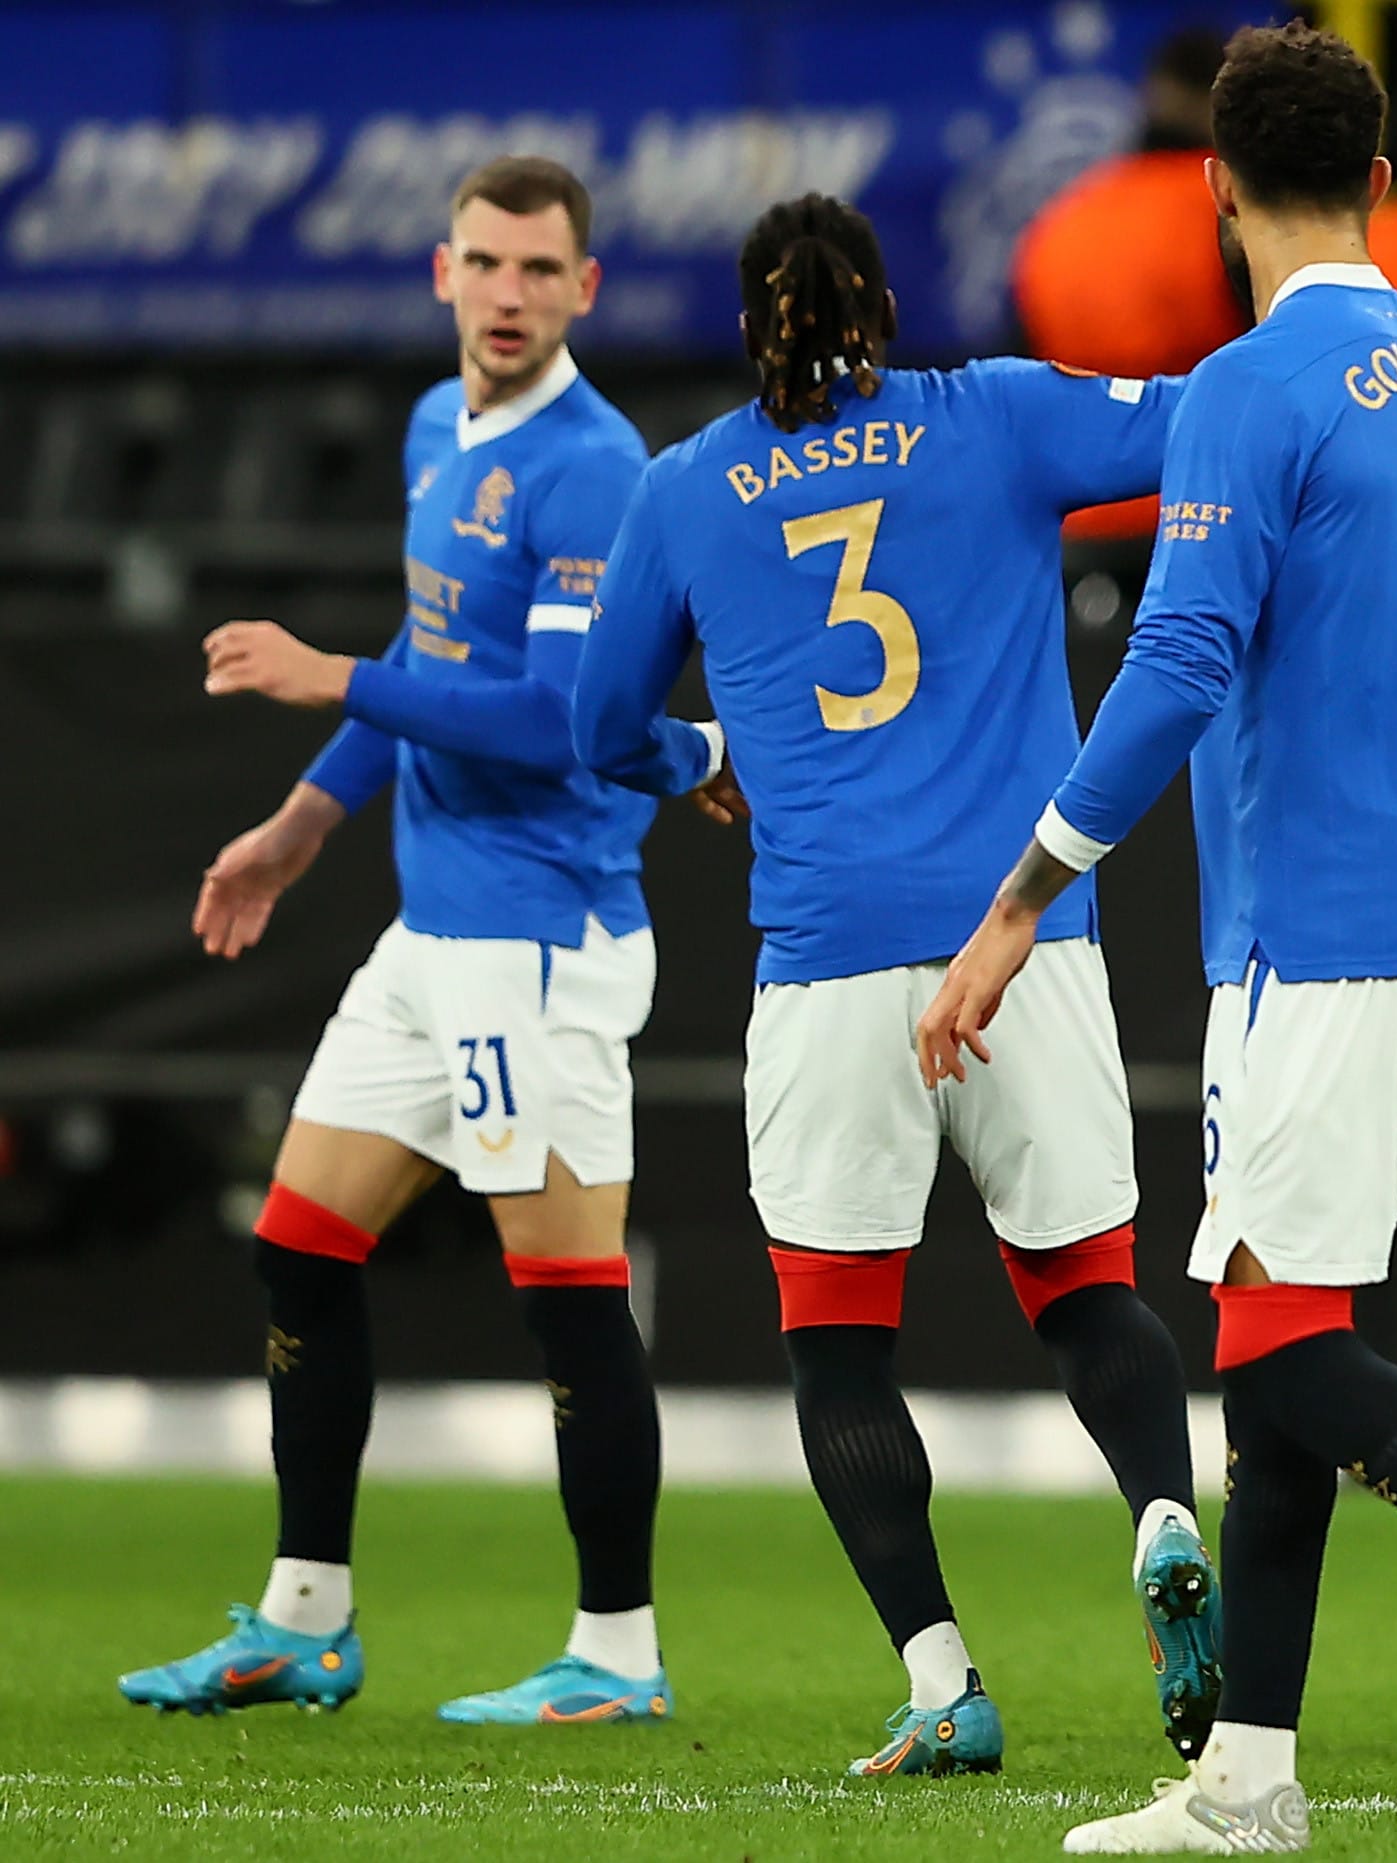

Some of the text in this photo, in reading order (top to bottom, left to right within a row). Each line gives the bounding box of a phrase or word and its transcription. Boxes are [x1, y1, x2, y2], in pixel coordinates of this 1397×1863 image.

[726, 421, 925, 504] BASSEY
[782, 499, 921, 731] 3
[458, 1036, 518, 1121] 31
